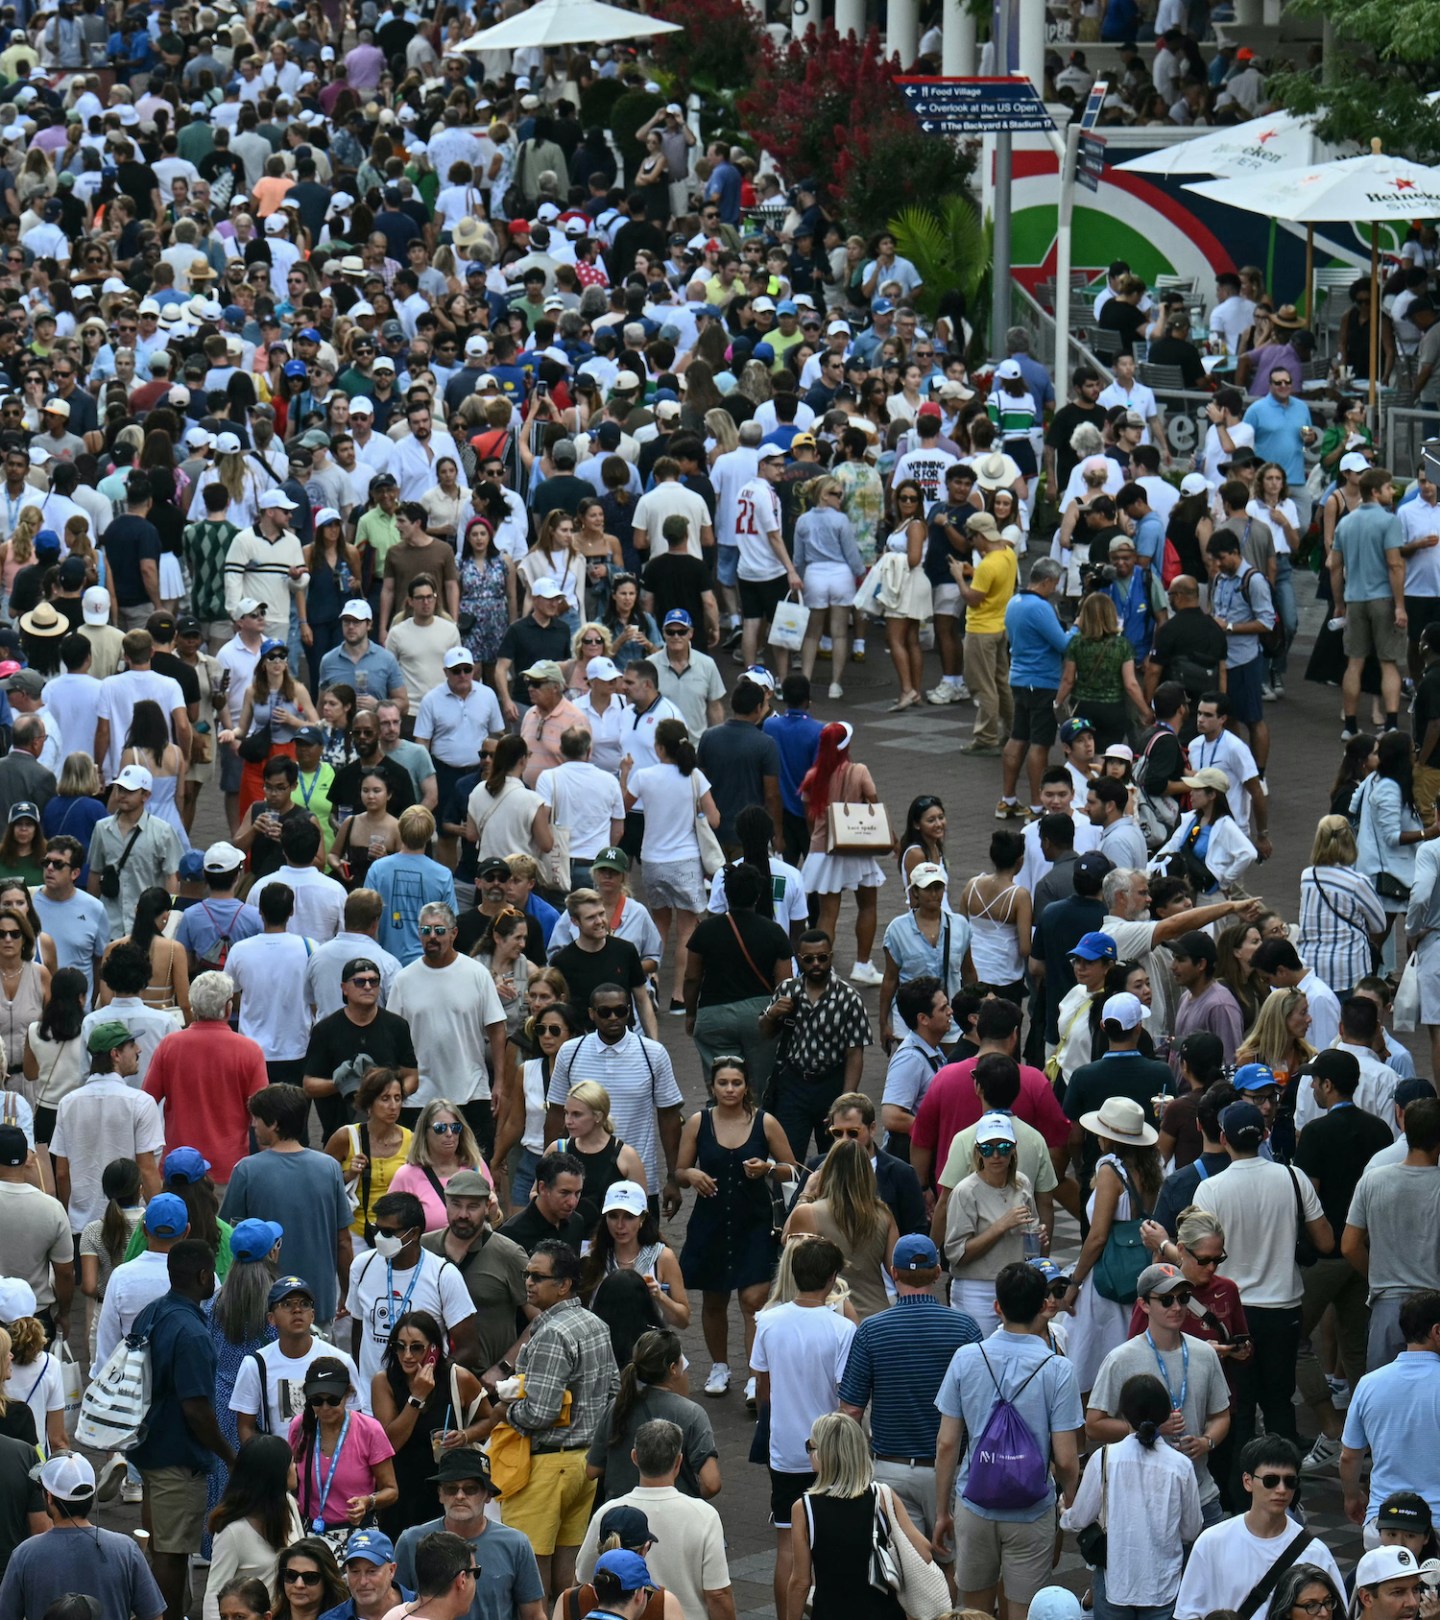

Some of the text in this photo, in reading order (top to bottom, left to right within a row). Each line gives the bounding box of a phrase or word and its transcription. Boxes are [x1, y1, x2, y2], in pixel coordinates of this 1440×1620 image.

[930, 87, 982, 98] Food Village
[928, 103, 1038, 115] Overlook at the US Open
[947, 120, 1052, 132] The Backyard & Stadium 17
[907, 460, 946, 471] WINNING
[913, 469, 939, 478] IS FOR
